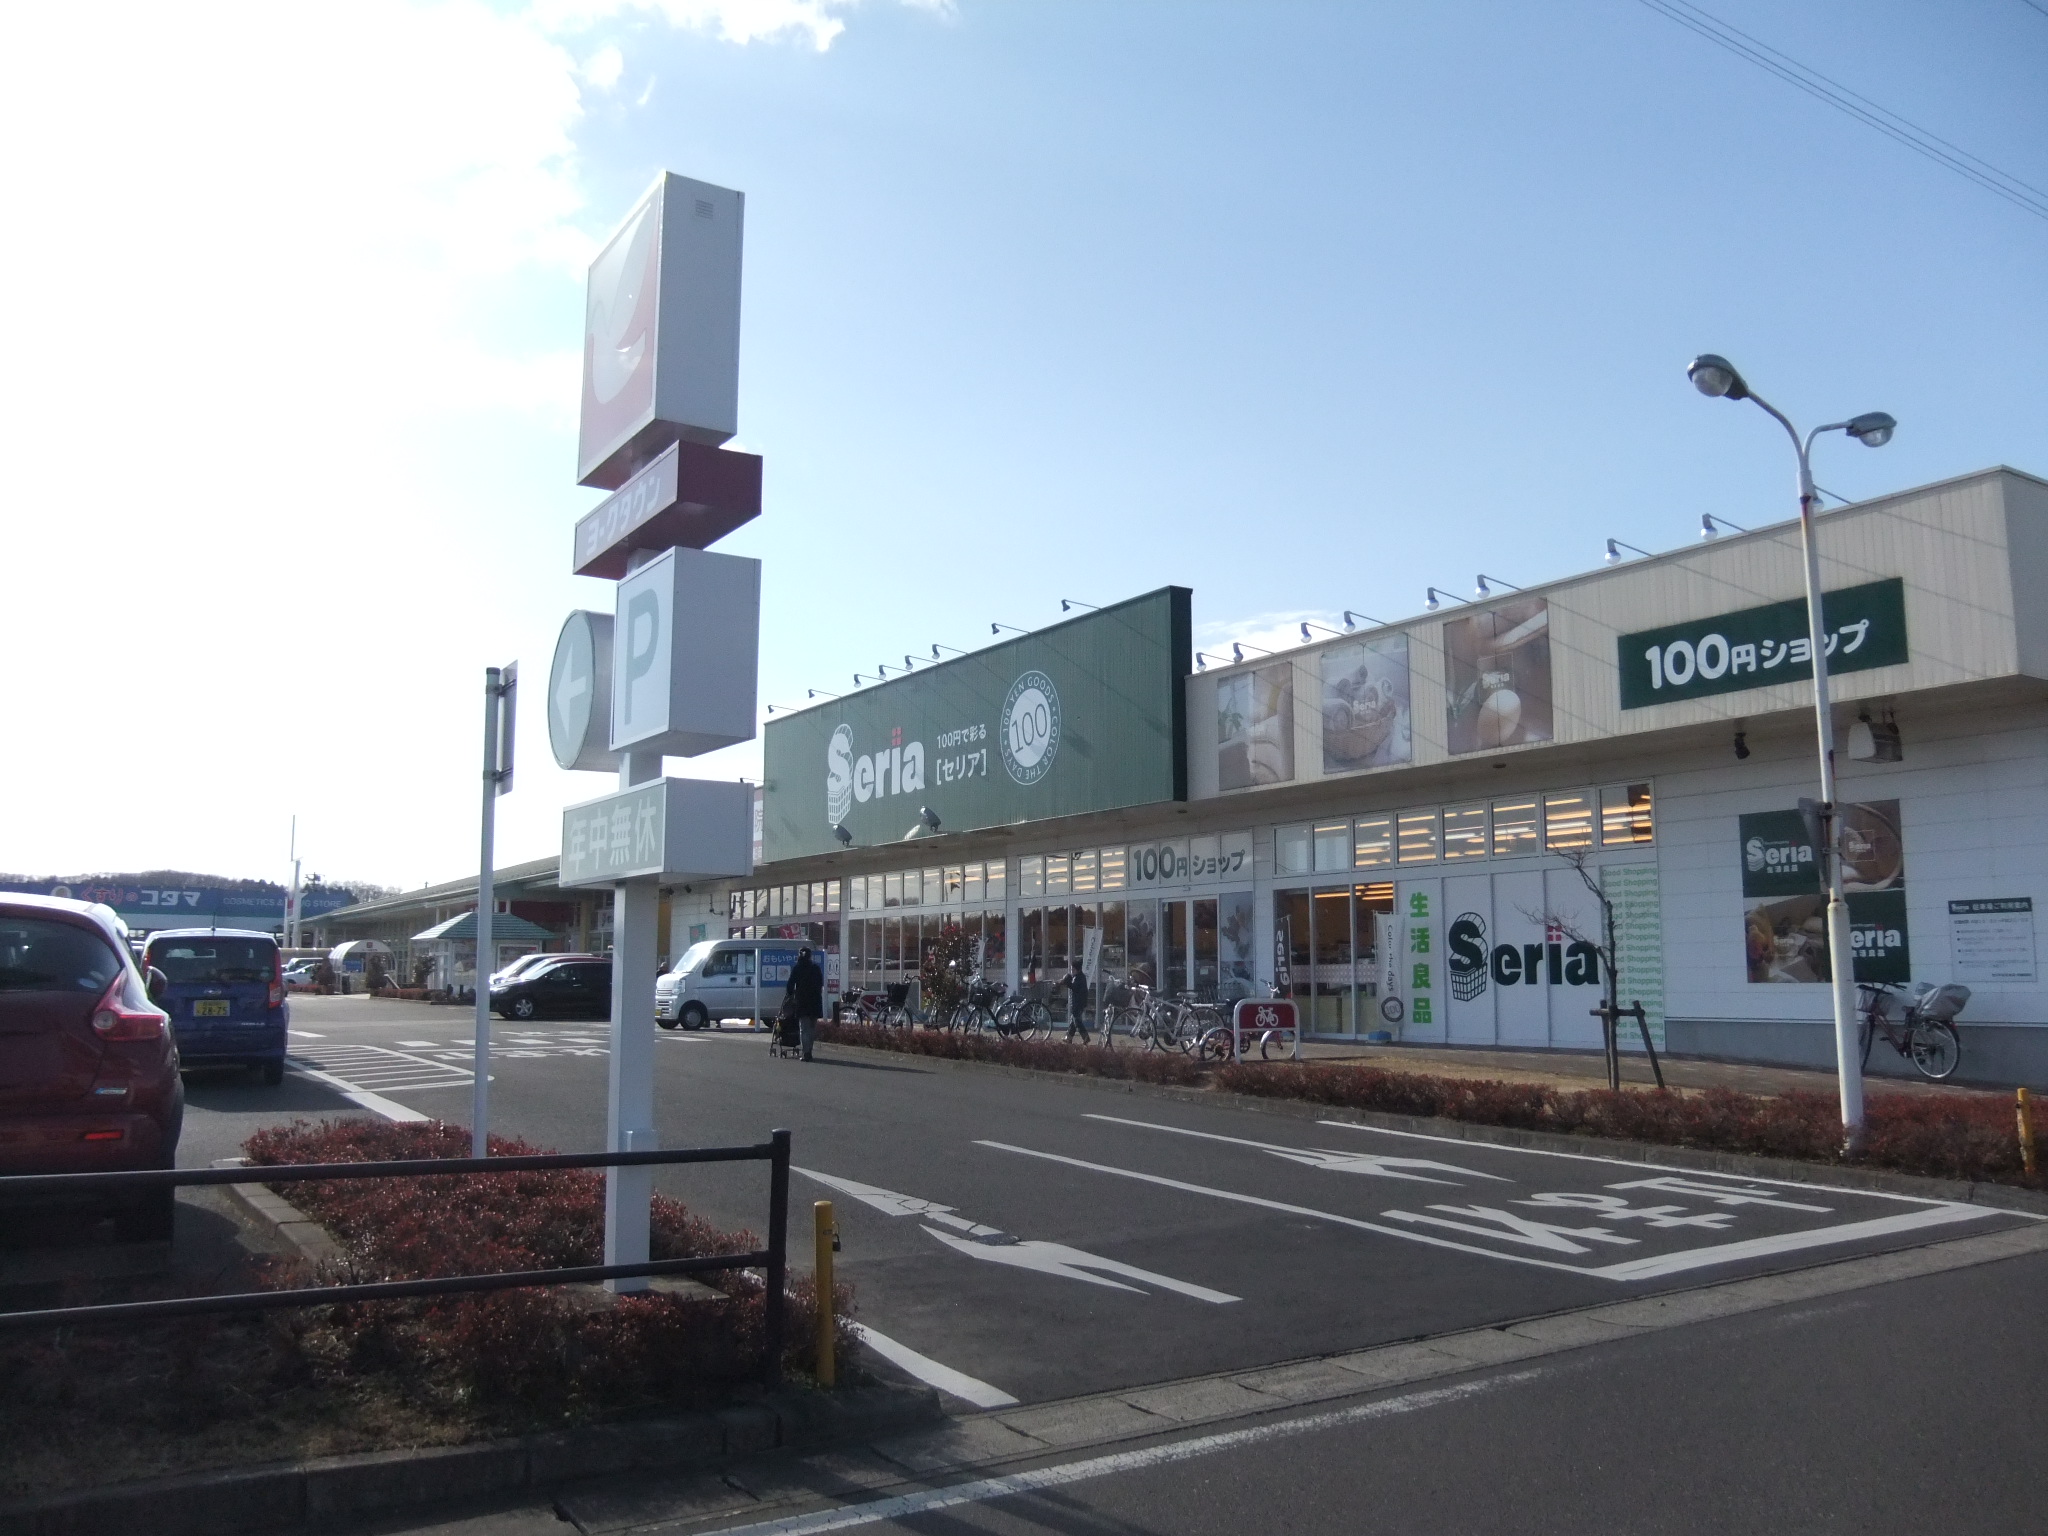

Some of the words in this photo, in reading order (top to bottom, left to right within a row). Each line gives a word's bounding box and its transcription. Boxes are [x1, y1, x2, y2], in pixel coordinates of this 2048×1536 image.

[587, 478, 660, 553] ヨークタウン
[625, 588, 660, 725] P
[1011, 703, 1048, 753] 100
[826, 724, 925, 820] Seria
[569, 800, 657, 871] 年中無休
[1746, 836, 1813, 871] Seria
[223, 897, 275, 906] COSMETICS
[313, 900, 342, 908] STORE
[1850, 924, 1902, 948] eria
[1409, 891, 1433, 1024] 生活良品
[1448, 912, 1600, 998] Seria
[1380, 1175, 1834, 1255] 止まれ
